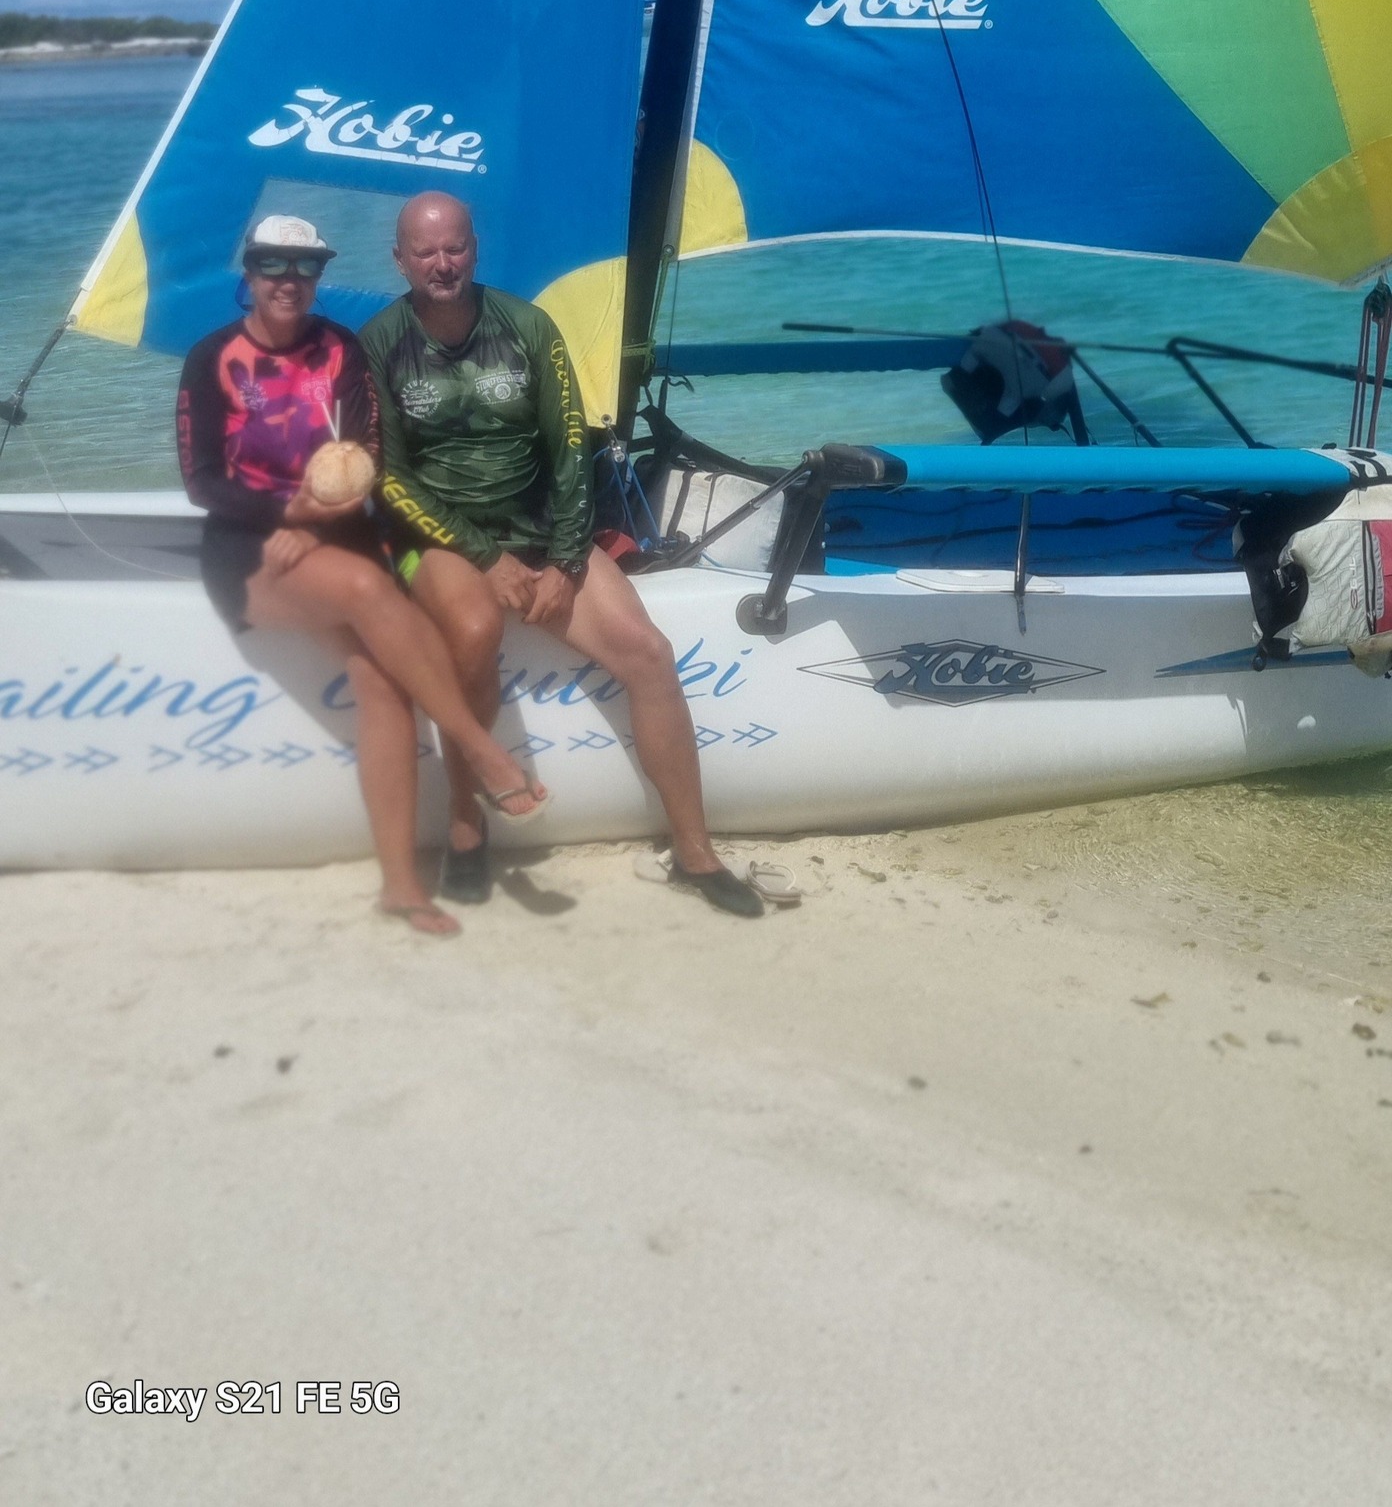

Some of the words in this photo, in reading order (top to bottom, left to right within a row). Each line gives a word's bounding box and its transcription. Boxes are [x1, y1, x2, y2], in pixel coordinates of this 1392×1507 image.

[248, 88, 484, 172] Hobie
[383, 476, 454, 544] EFISH
[873, 643, 1035, 694] Hobie
